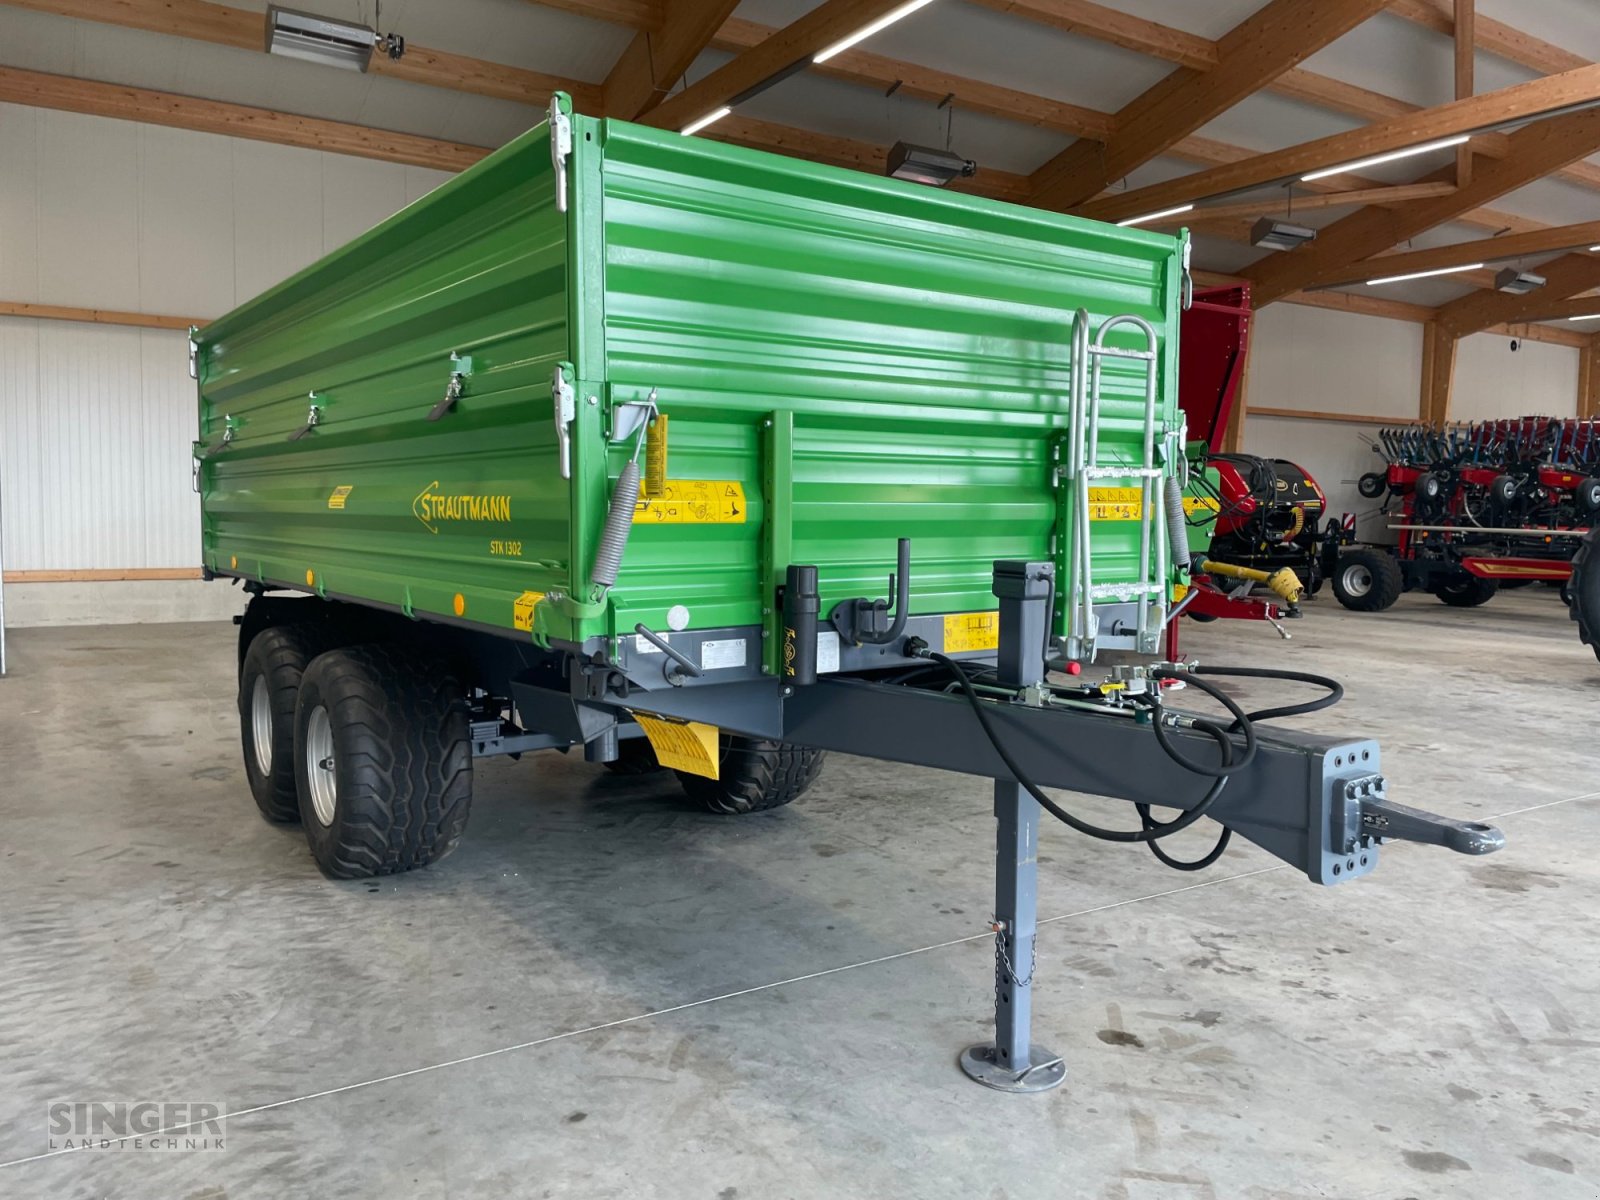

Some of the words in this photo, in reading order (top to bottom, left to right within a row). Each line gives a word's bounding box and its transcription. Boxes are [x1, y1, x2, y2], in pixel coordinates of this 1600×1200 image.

[421, 493, 511, 522] STRAUTMANN
[490, 540, 504, 555] STK
[505, 541, 522, 556] 1302
